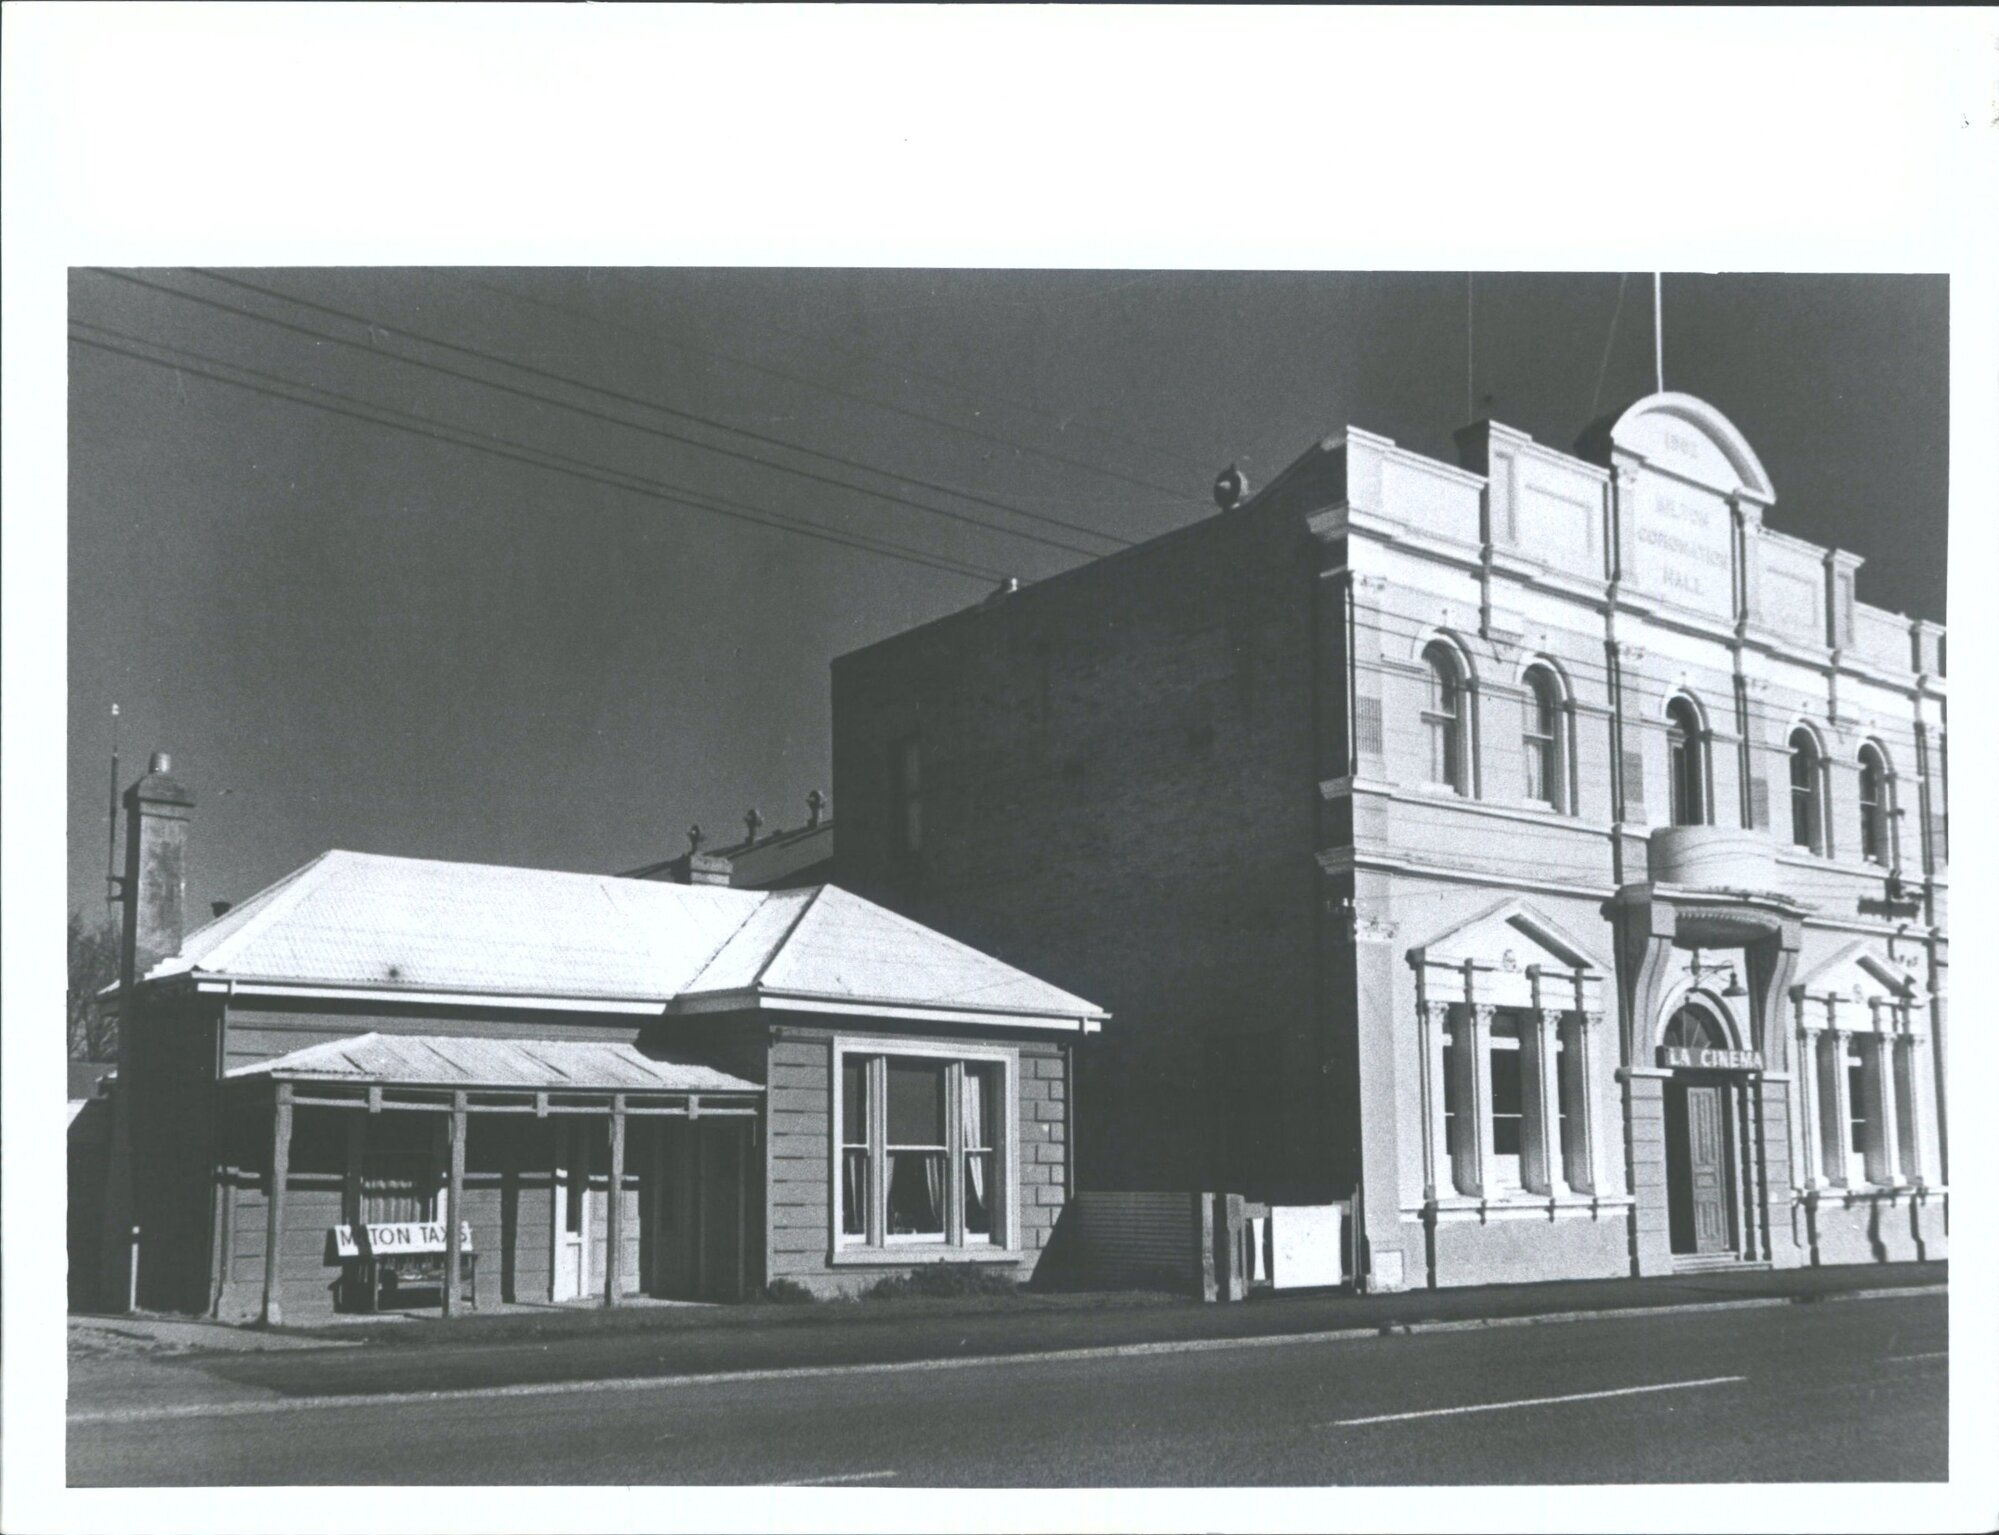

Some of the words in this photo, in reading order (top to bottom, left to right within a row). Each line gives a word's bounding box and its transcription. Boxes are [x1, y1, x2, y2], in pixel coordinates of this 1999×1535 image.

[1637, 525, 1729, 570] CORONATION
[1662, 562, 1704, 596] HALL
[1669, 1047, 1691, 1066] LA
[1700, 1049, 1764, 1069] CINEMA
[340, 1227, 411, 1246] MTON
[420, 1226, 468, 1243] TAXS
